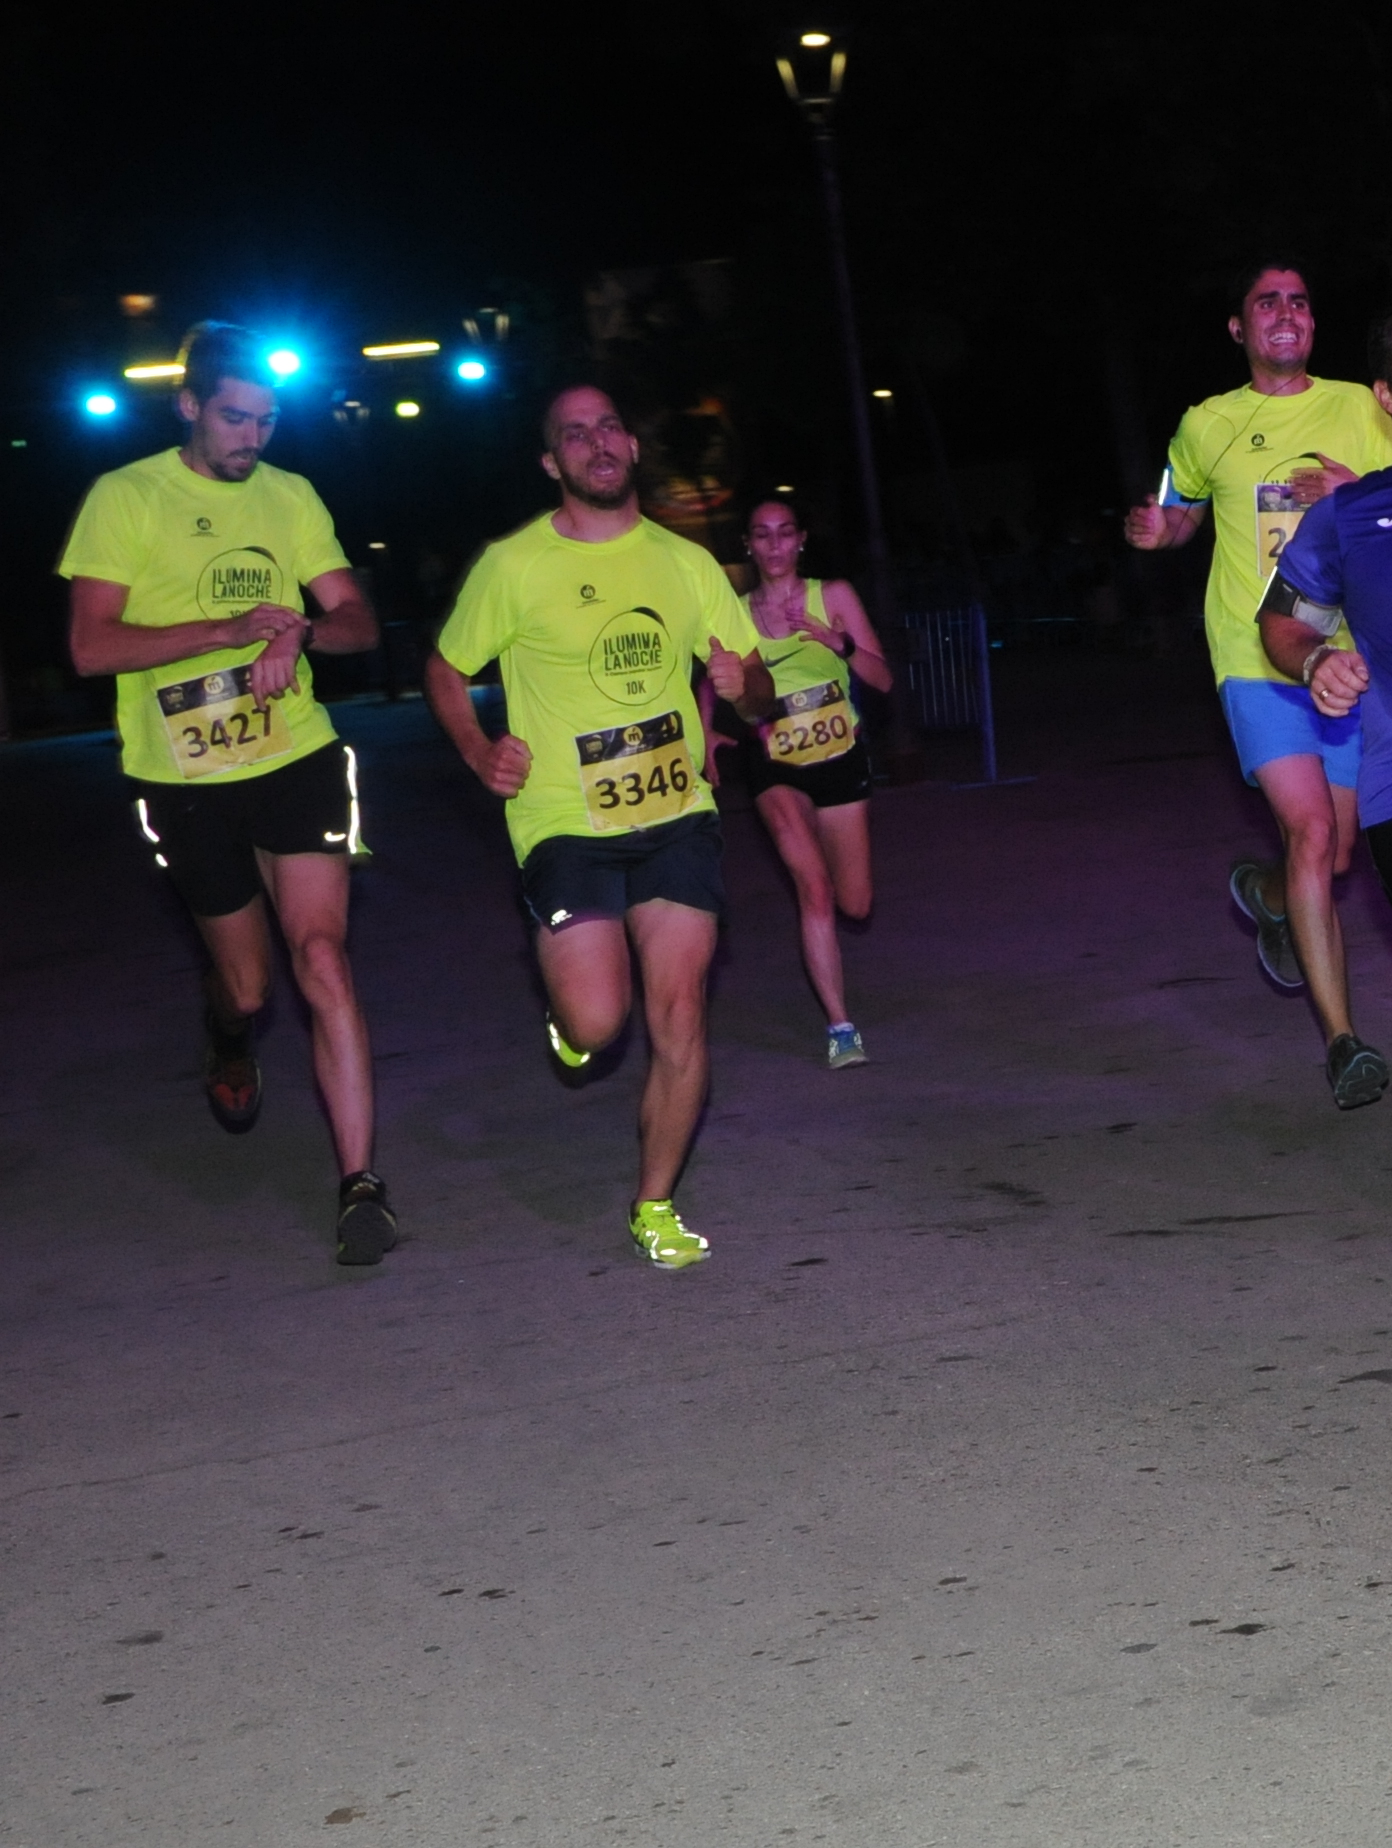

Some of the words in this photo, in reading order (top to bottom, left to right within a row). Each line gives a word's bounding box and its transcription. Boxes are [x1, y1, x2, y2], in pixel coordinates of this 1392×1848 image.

[212, 567, 272, 585] ILUMINA
[625, 680, 647, 696] 10K
[182, 704, 272, 758] 3427
[775, 715, 848, 756] 3280
[595, 758, 689, 810] 3346
